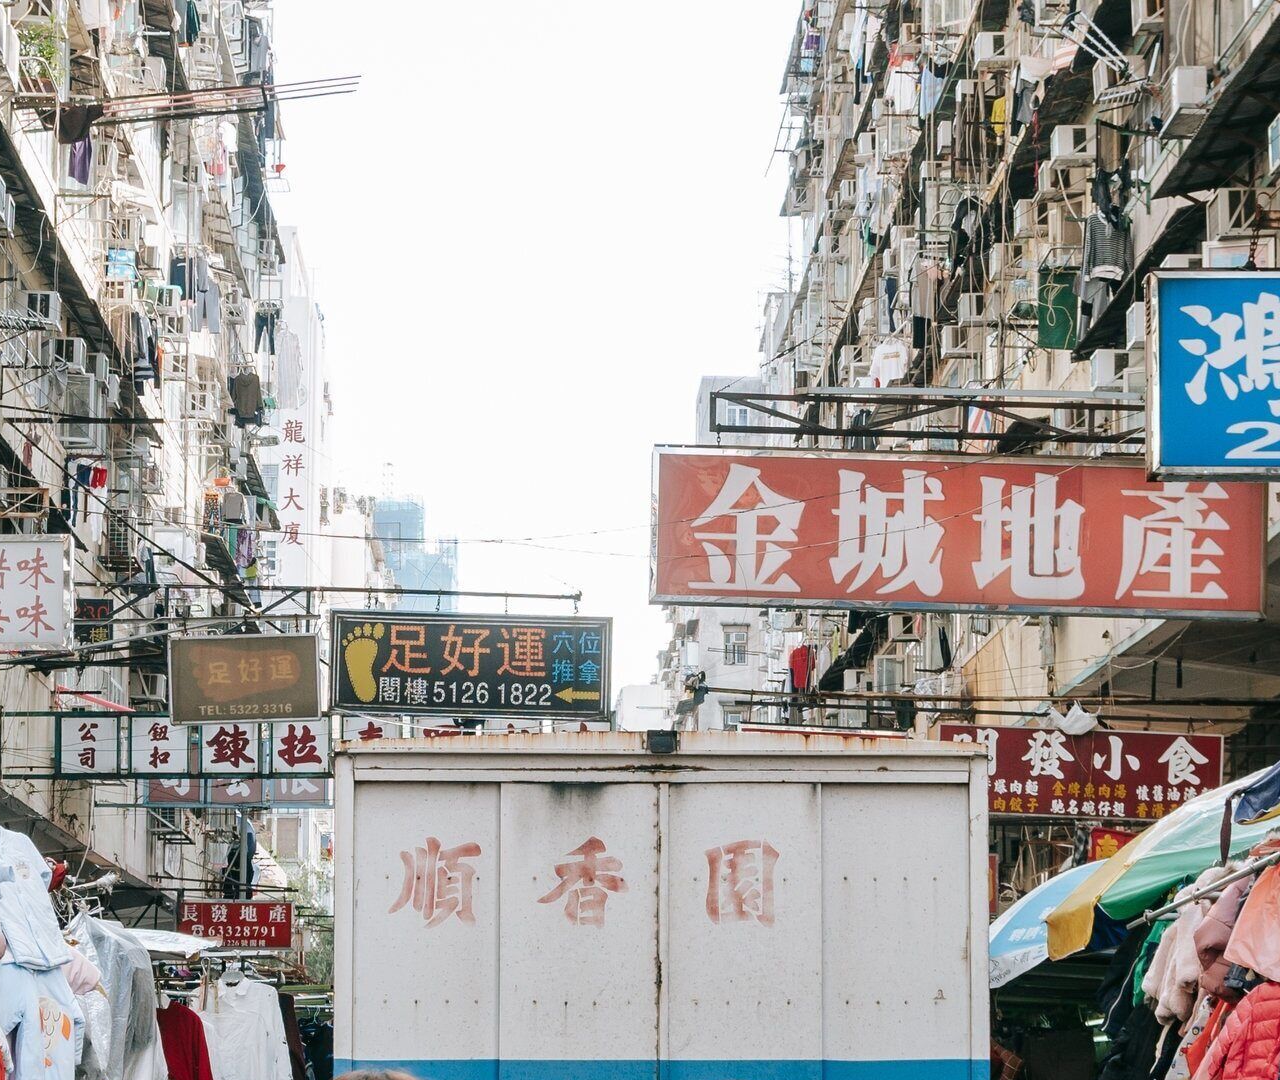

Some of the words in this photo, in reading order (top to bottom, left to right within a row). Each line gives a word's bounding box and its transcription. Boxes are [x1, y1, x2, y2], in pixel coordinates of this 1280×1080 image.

[280, 418, 306, 546] 龍祥大廈
[686, 462, 1231, 601] 金城地產
[382, 623, 547, 677] 足好運
[552, 630, 601, 655] 穴位
[207, 654, 295, 686] 足好運
[552, 659, 601, 685] 推拿
[378, 676, 429, 705] 閣樓
[432, 681, 490, 705] 5126
[497, 683, 552, 706] 1822
[199, 704, 227, 716] TEL:
[229, 704, 260, 715] 5322
[262, 703, 293, 714] 3316
[1136, 784, 1216, 802] 懷舊油渣
[1136, 804, 1178, 818] 香滑
[181, 904, 287, 923] 長發地產
[208, 926, 277, 937] 63328791
